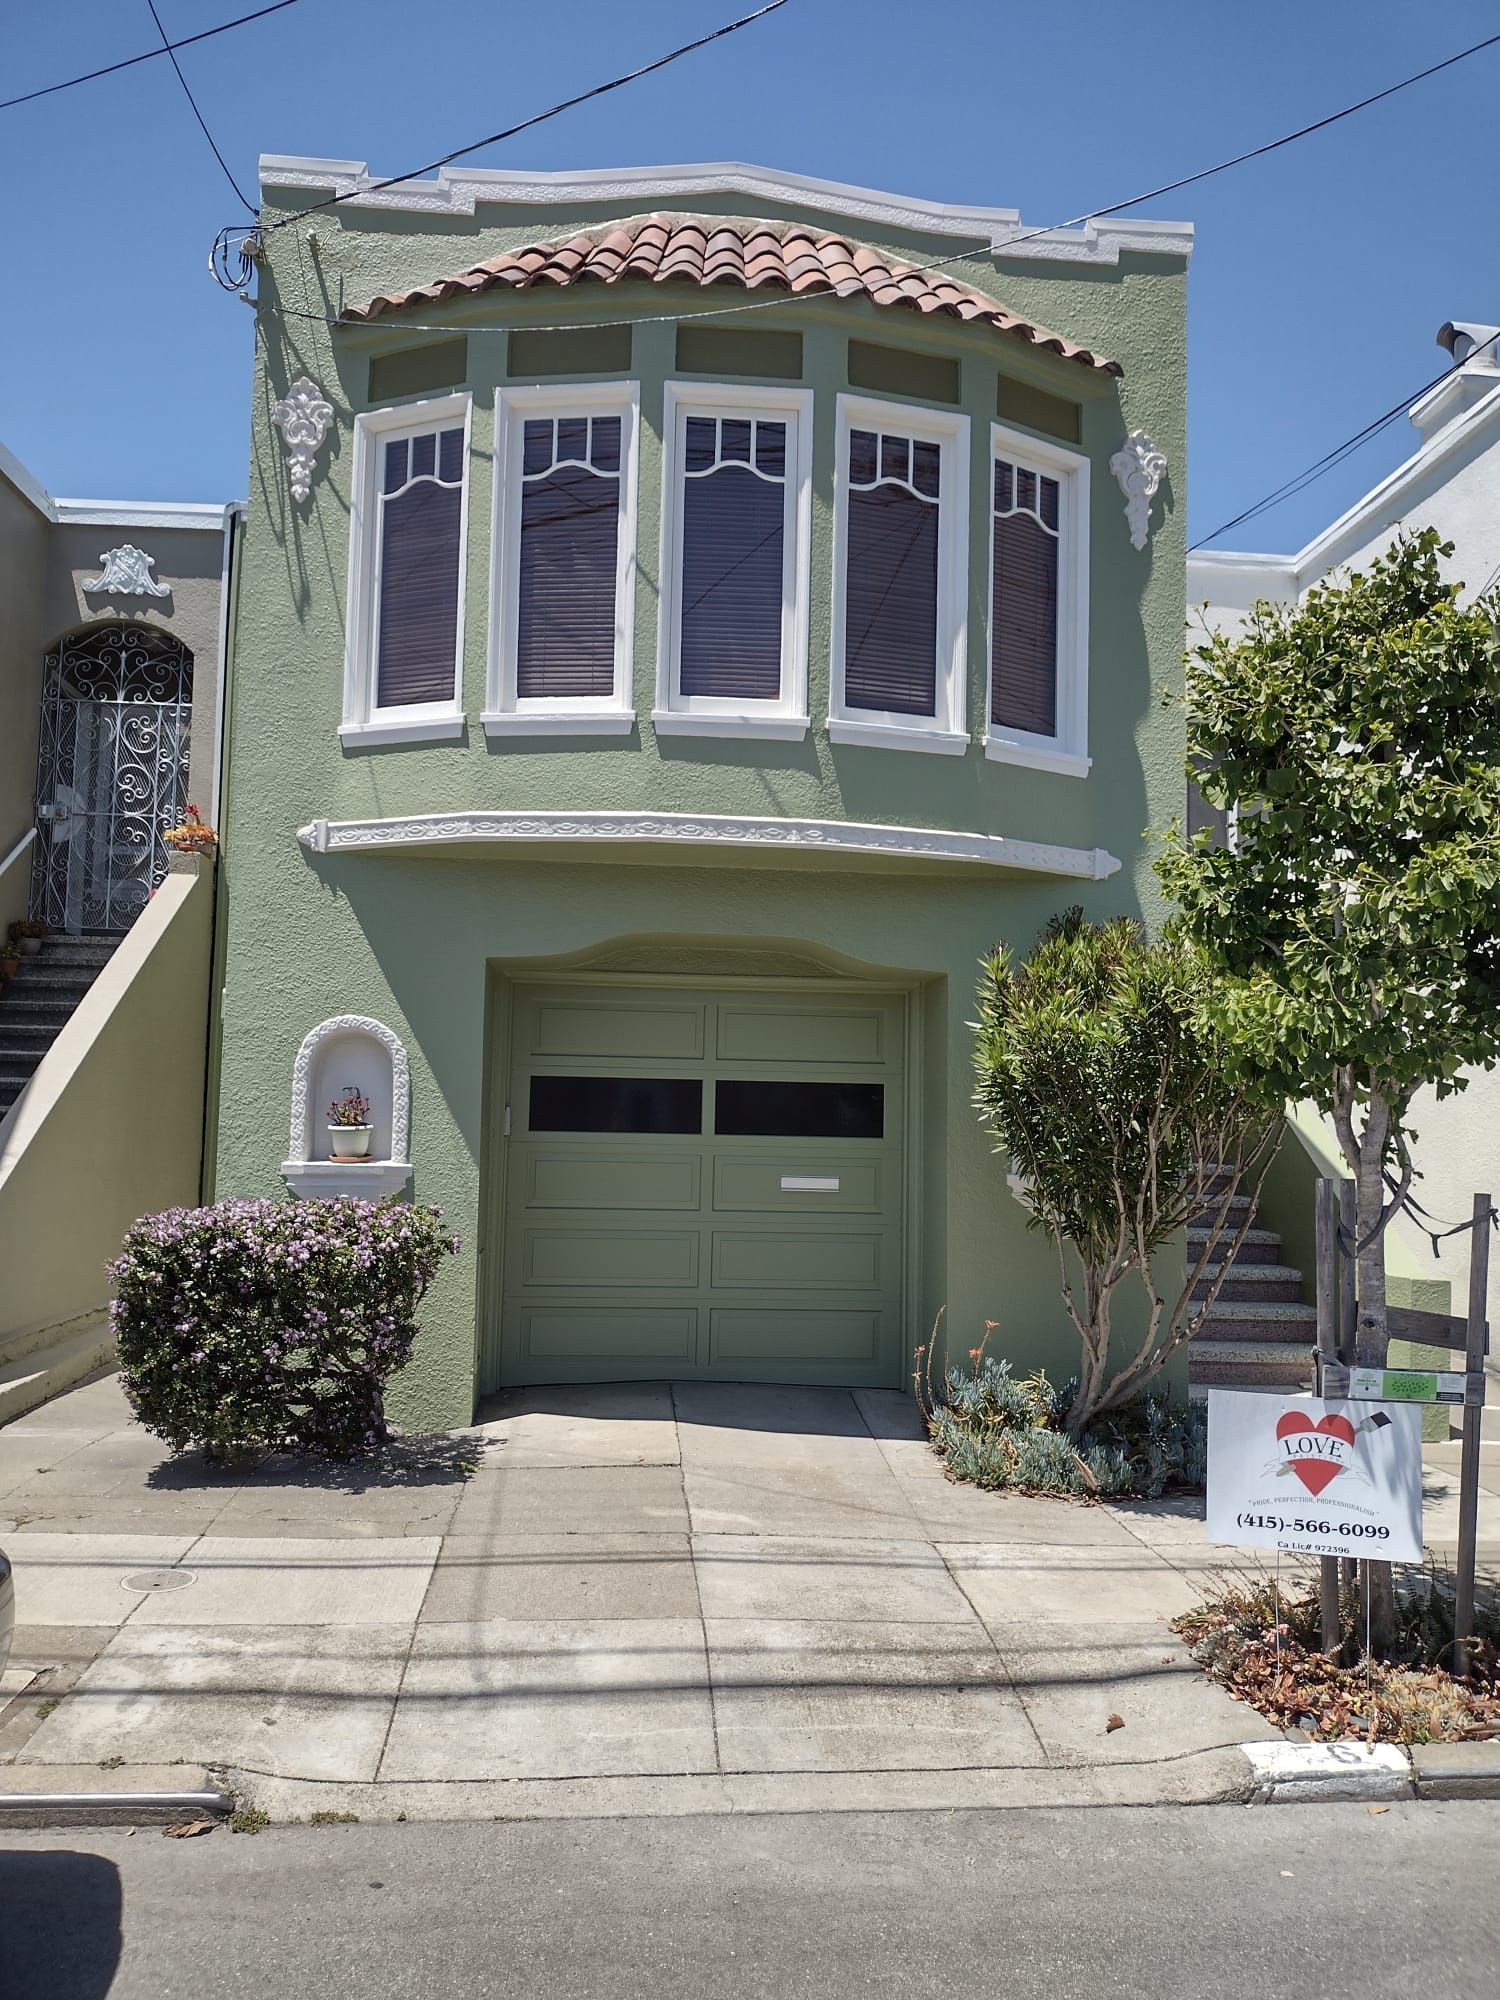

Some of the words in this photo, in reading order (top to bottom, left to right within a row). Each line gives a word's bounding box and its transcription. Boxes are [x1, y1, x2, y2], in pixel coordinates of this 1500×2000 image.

[1283, 1437, 1344, 1458] LOVE
[1237, 1513, 1390, 1539] (415)-566-6099
[1277, 1541, 1289, 1549] Ca
[1292, 1542, 1312, 1551] Lic#
[1314, 1544, 1350, 1554] 972396
